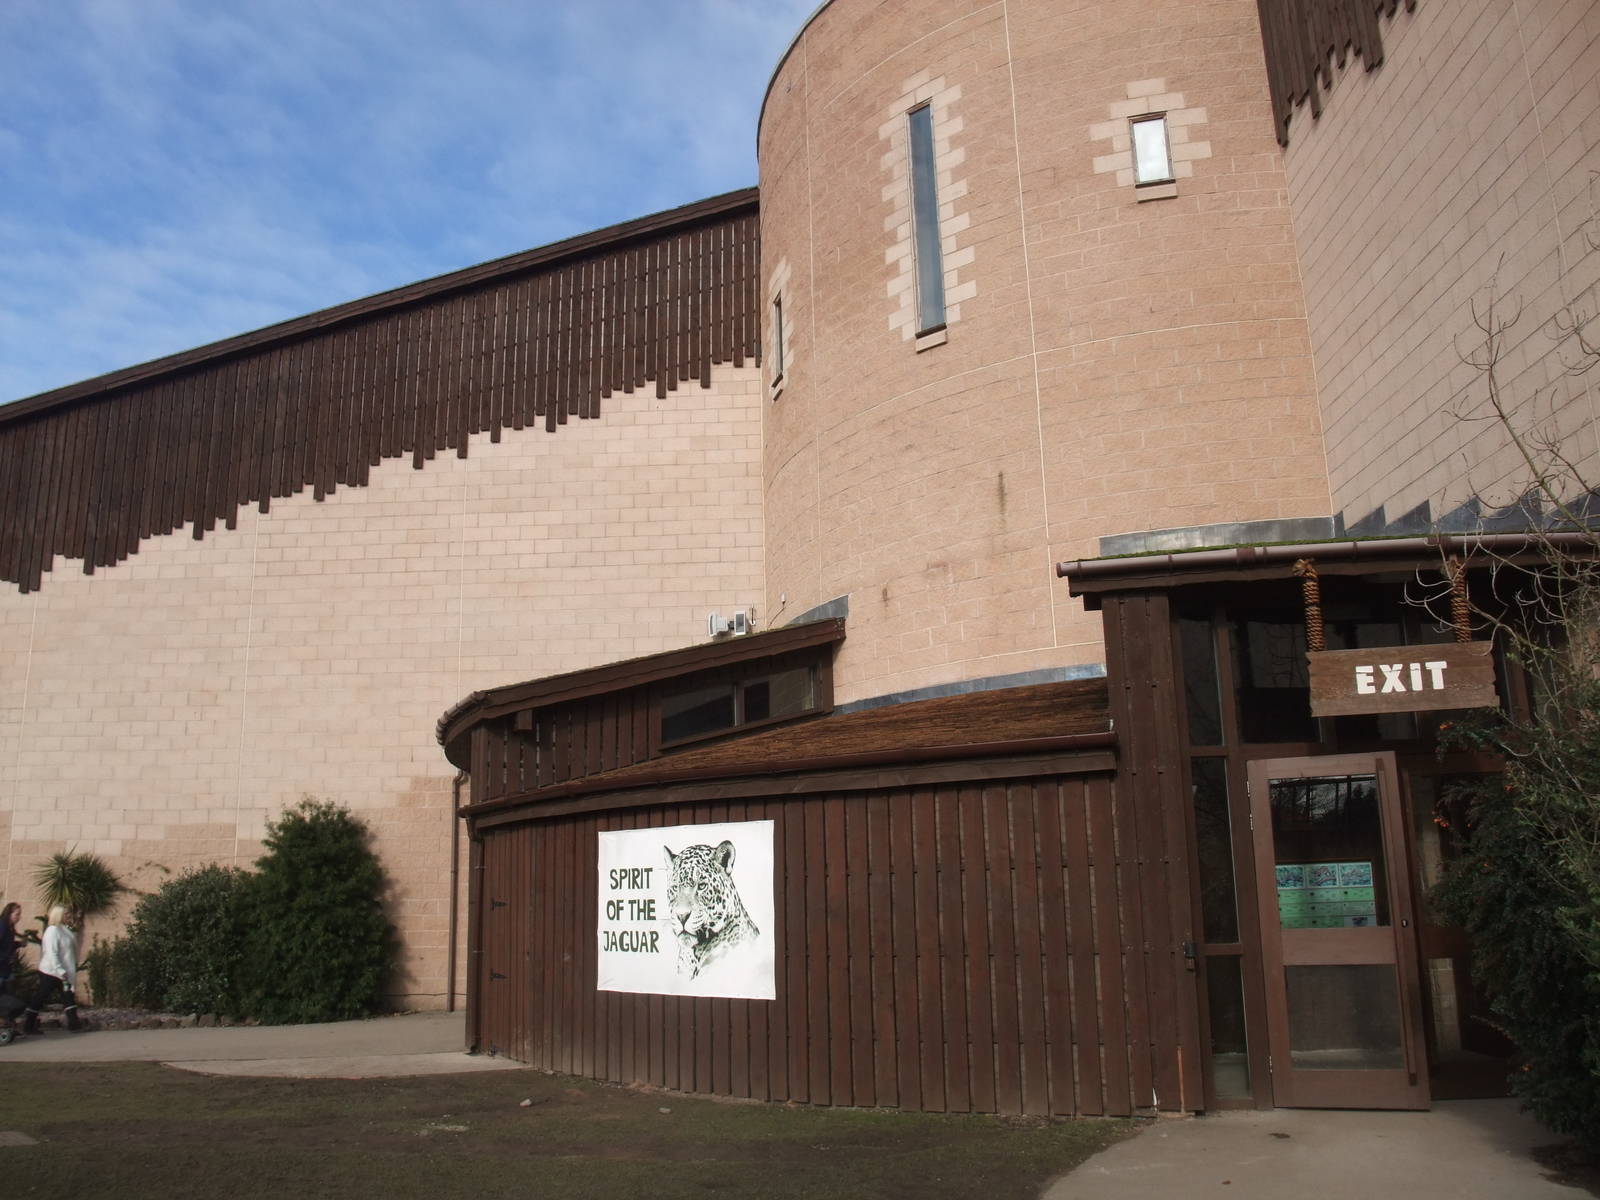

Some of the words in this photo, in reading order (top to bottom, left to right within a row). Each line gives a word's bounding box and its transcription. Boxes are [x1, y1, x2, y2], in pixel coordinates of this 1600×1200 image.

[1355, 661, 1447, 694] EXIT
[609, 867, 653, 890] SPIRIT
[606, 899, 624, 921] OF
[628, 899, 656, 921] THE
[603, 930, 660, 953] JAGUAR
